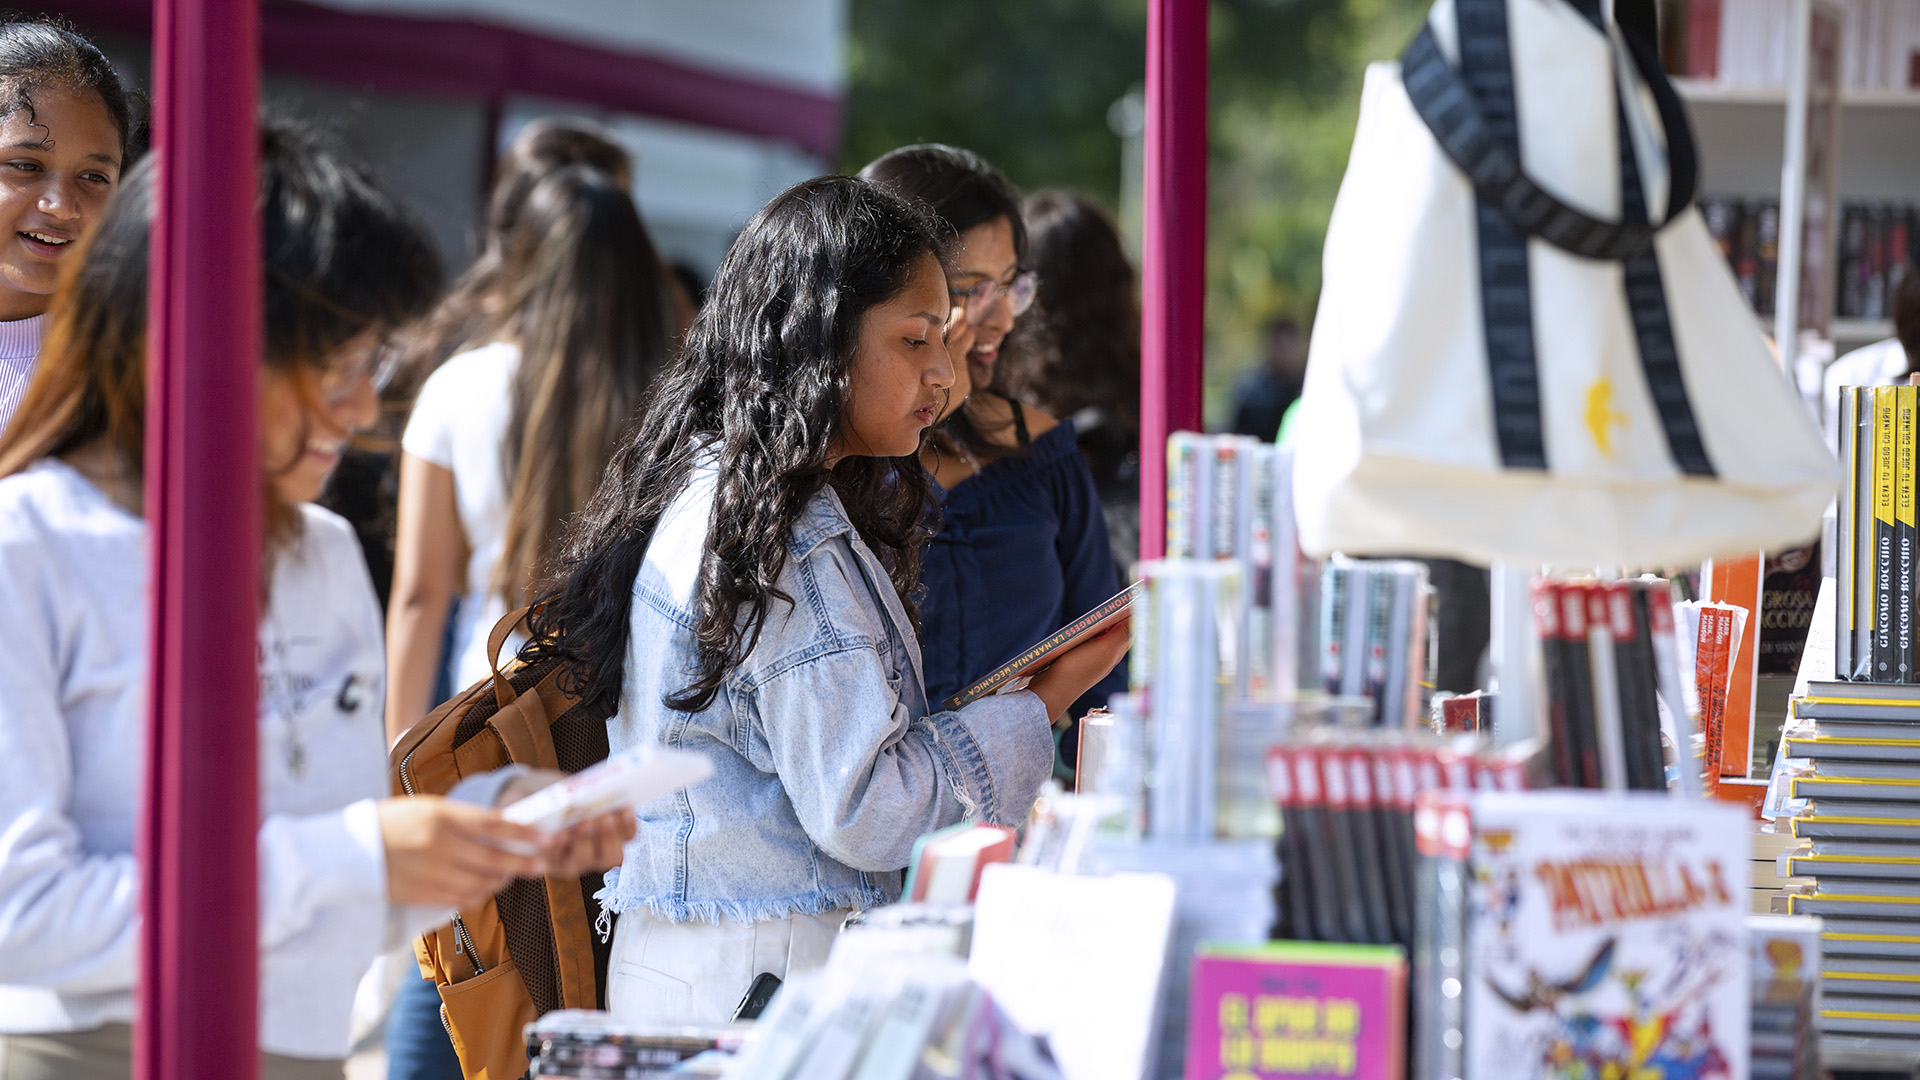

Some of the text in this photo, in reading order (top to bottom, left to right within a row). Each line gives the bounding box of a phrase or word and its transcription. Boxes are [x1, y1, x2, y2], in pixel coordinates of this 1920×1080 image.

[1882, 407, 1891, 507] ELEVA TU JUEGO CULINARIO
[1902, 408, 1911, 508] ELEVA TU JUEGO CULINARIO
[1065, 612, 1102, 637] BURGESS
[1104, 588, 1138, 614] NTHONY
[1880, 537, 1890, 648] GIACOMO BOCCHIO
[1900, 538, 1910, 649] GIACOMO BOCCHIO
[1012, 641, 1052, 669] NARANJA
[1053, 634, 1065, 645] LA
